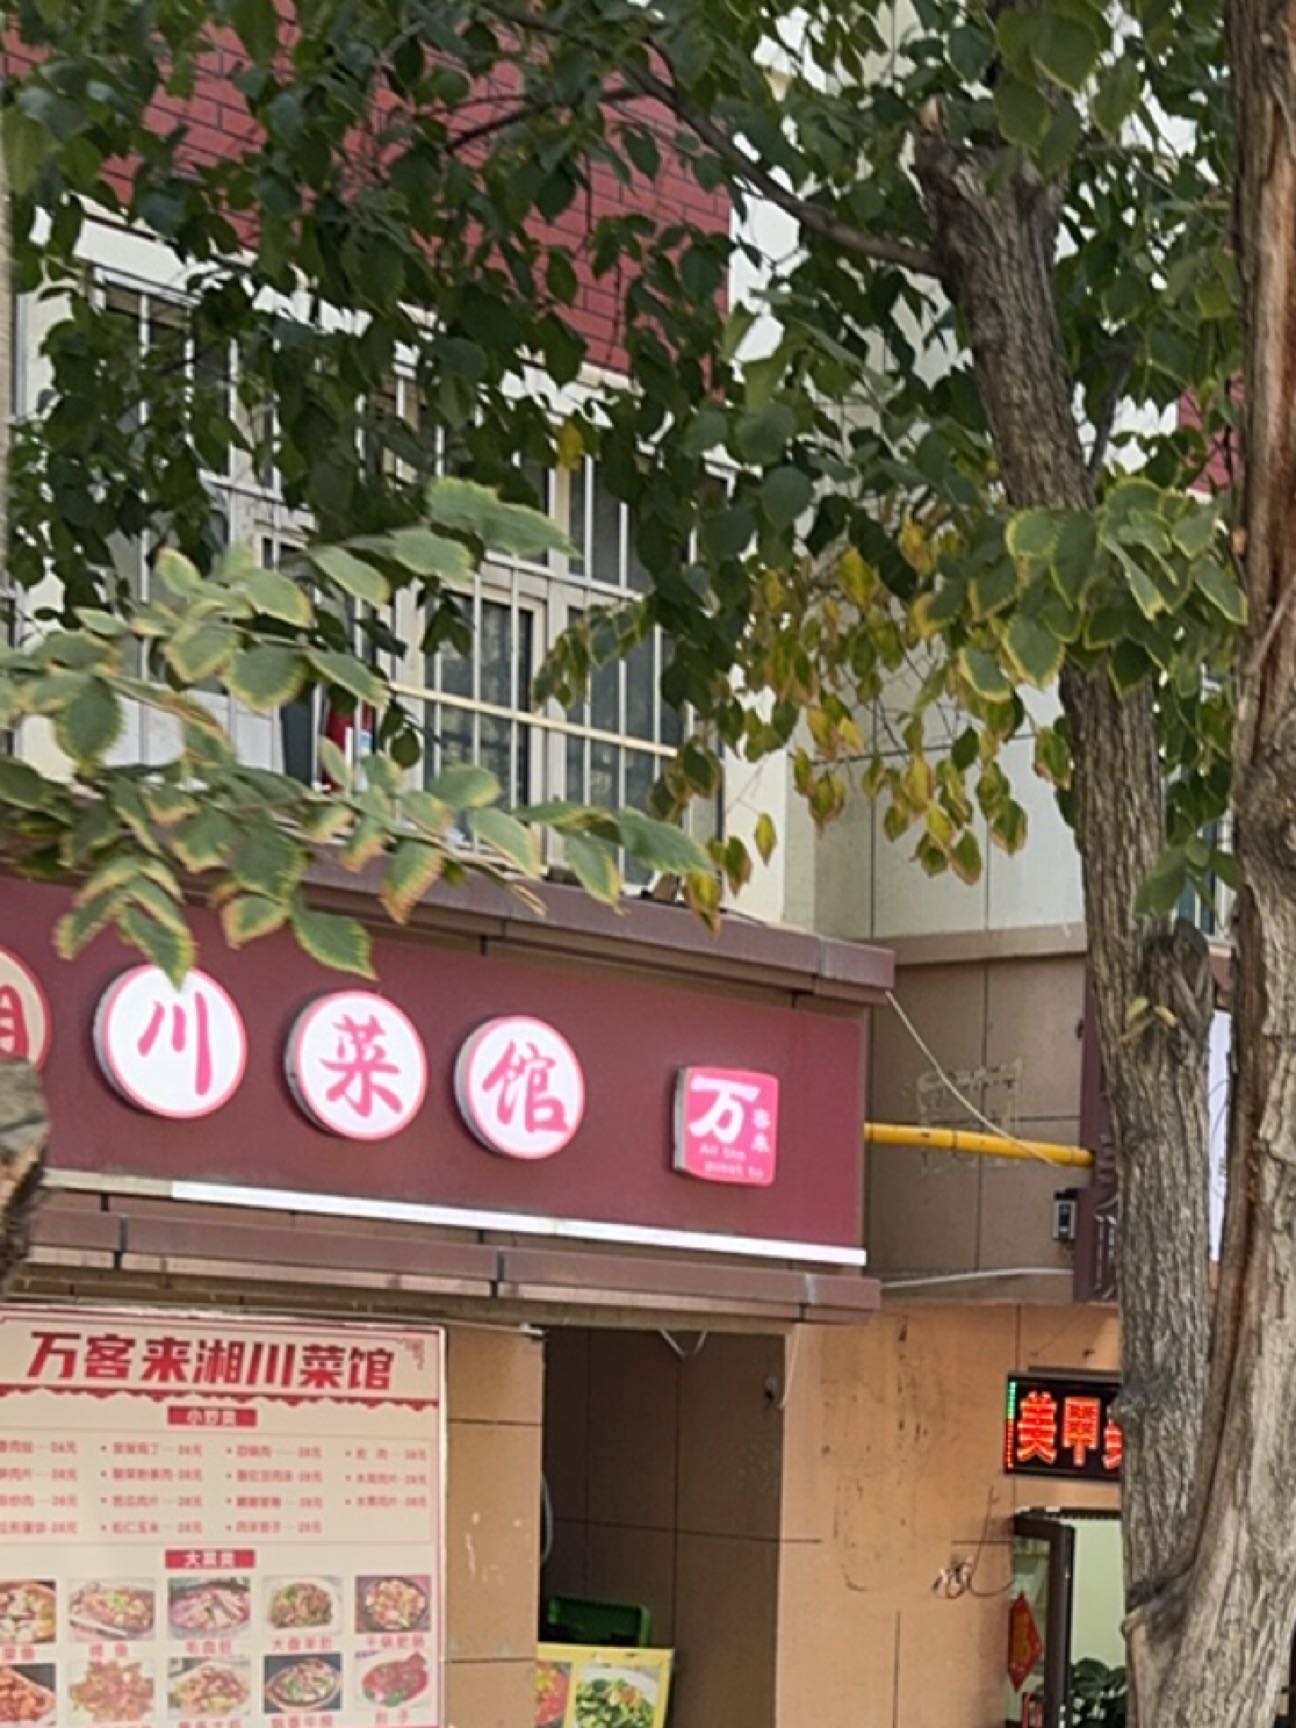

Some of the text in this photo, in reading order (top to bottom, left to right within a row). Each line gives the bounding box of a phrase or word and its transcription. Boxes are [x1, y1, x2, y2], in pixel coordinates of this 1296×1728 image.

[689, 1074, 761, 1145] 万
[26, 1330, 396, 1391] 万客来湘川菜馆
